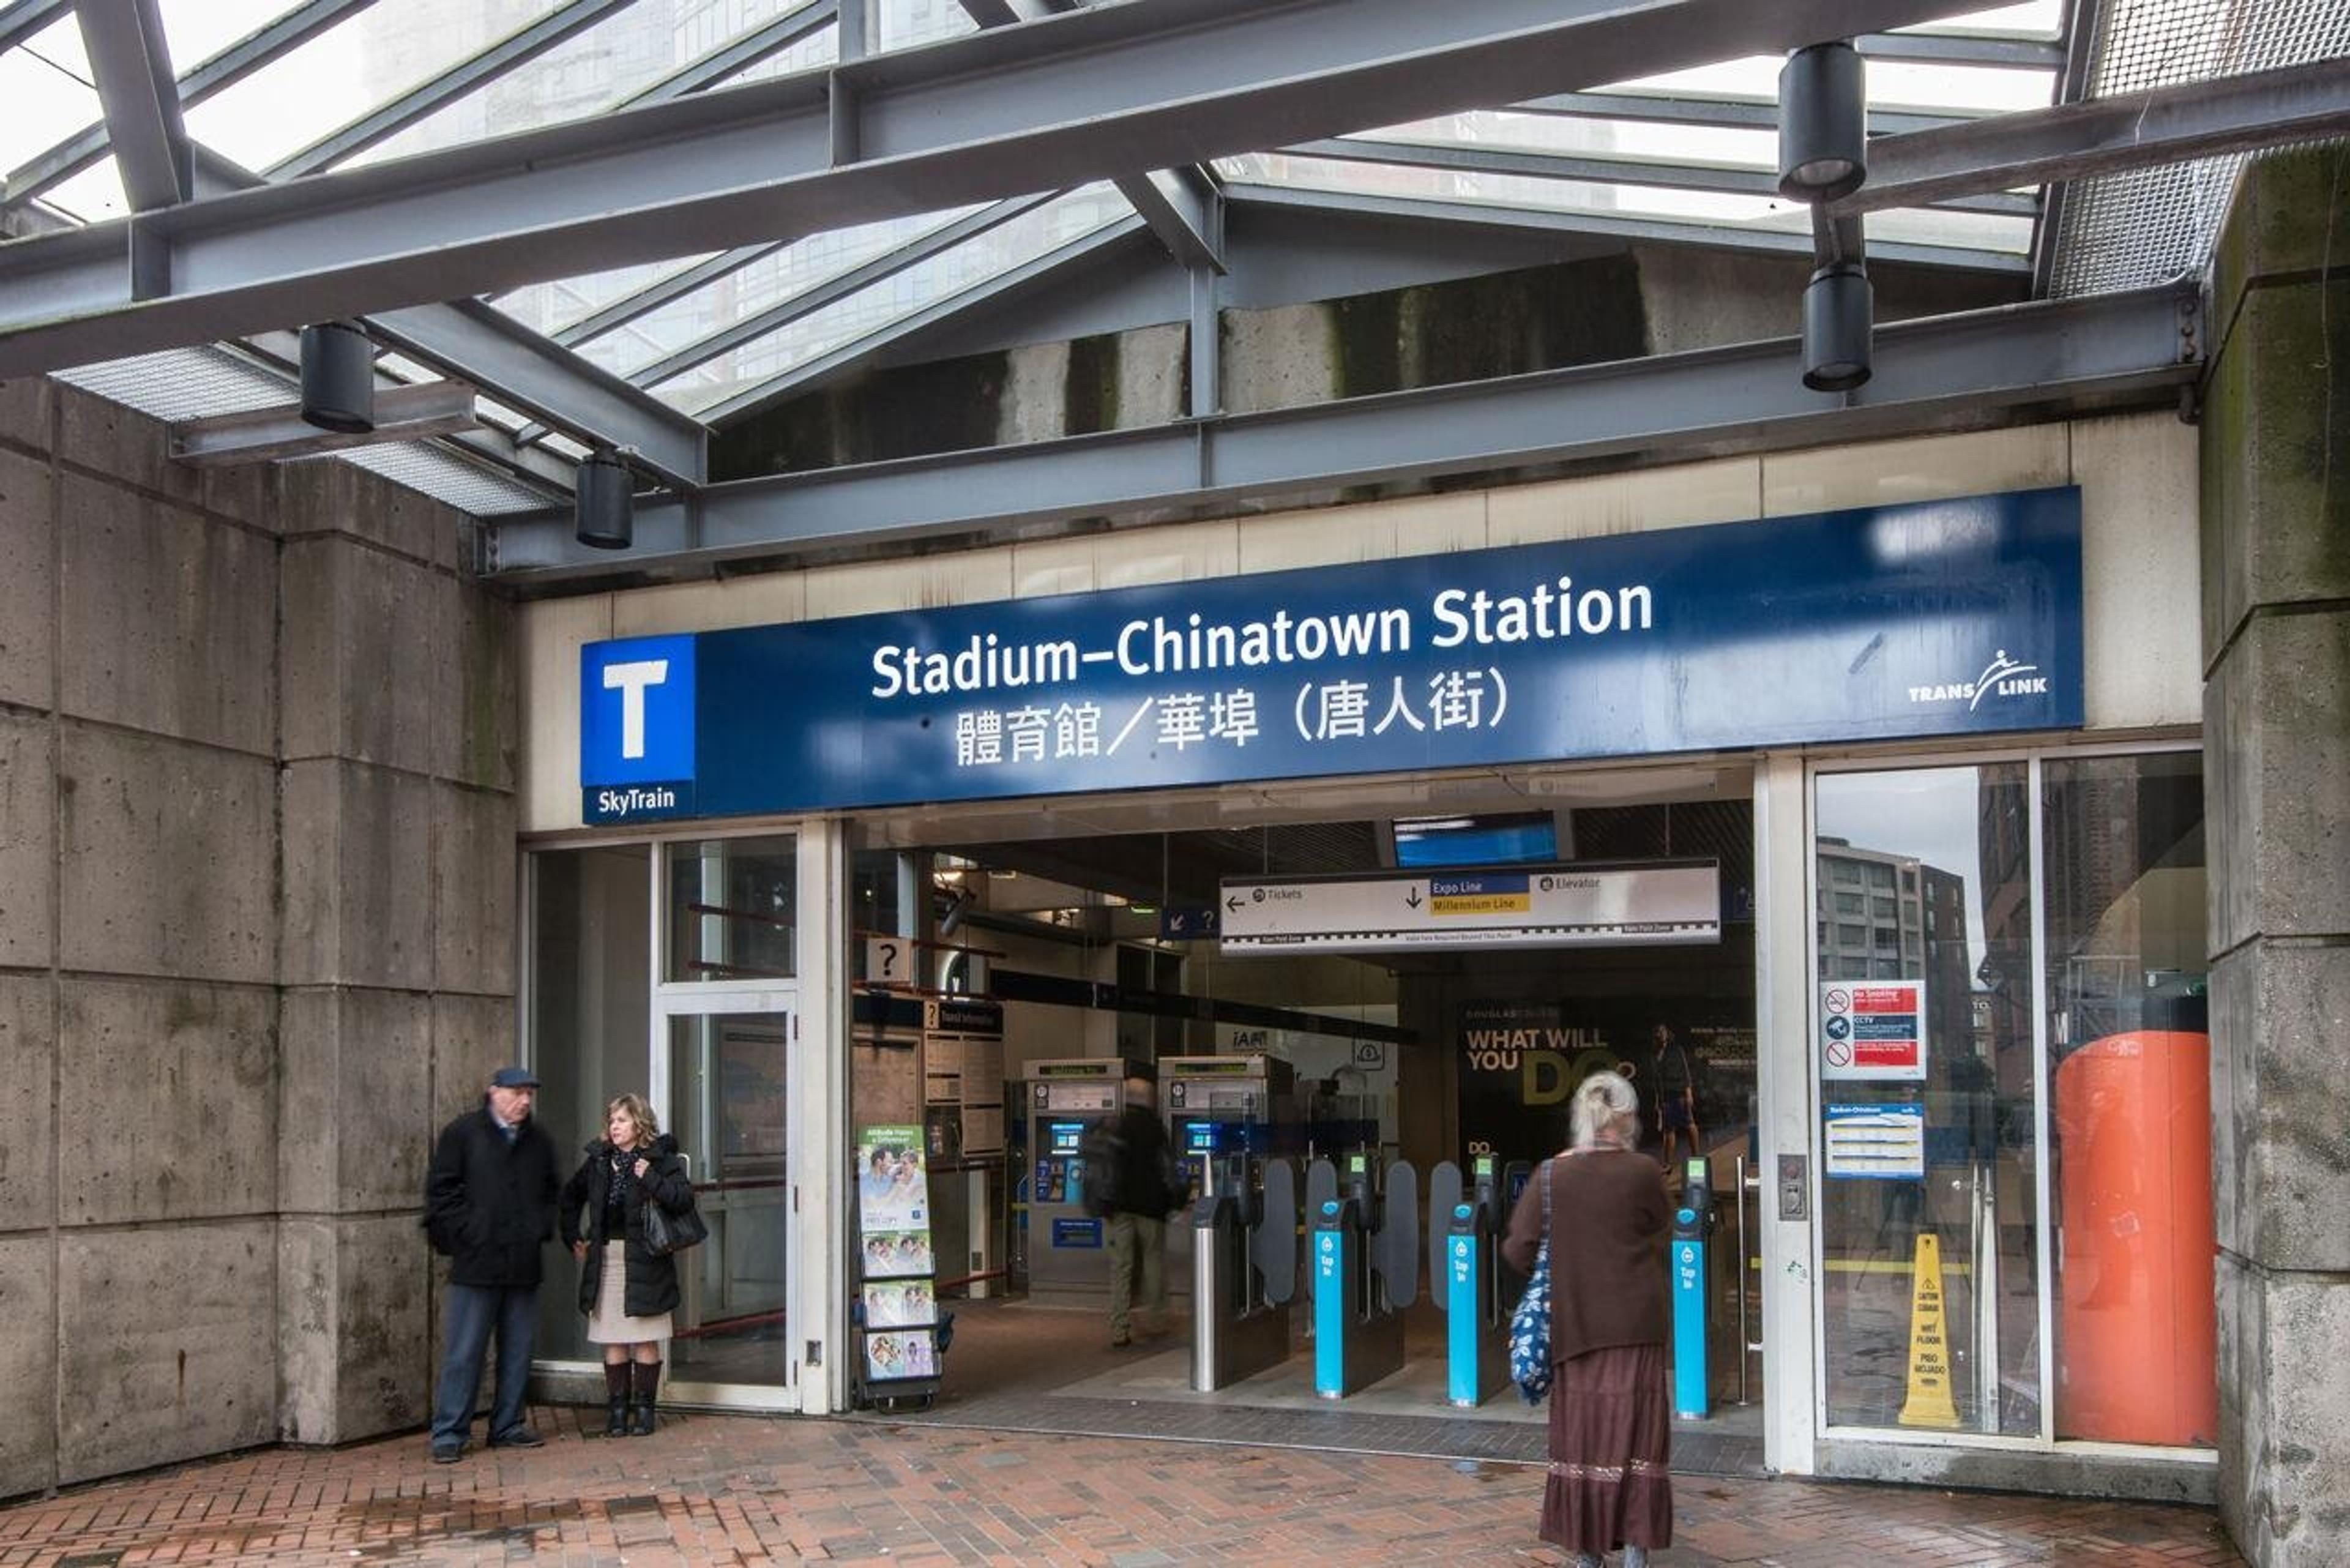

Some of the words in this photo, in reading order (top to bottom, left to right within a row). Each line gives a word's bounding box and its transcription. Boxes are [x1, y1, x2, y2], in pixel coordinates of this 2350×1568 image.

[1433, 576, 1652, 648] Station
[603, 659, 668, 759] T
[599, 788, 675, 816] SkyTrain
[1433, 883, 1458, 895] Expo
[1461, 881, 1482, 892] Line
[1557, 877, 1601, 889] Elevator
[1268, 889, 1302, 900] Tickets
[1433, 900, 1492, 911] Millennium
[1494, 898, 1515, 909] Line
[1466, 1029, 1541, 1049] WHAT
[1546, 1028, 1609, 1048] WILL
[1467, 1050, 1519, 1070] YOU
